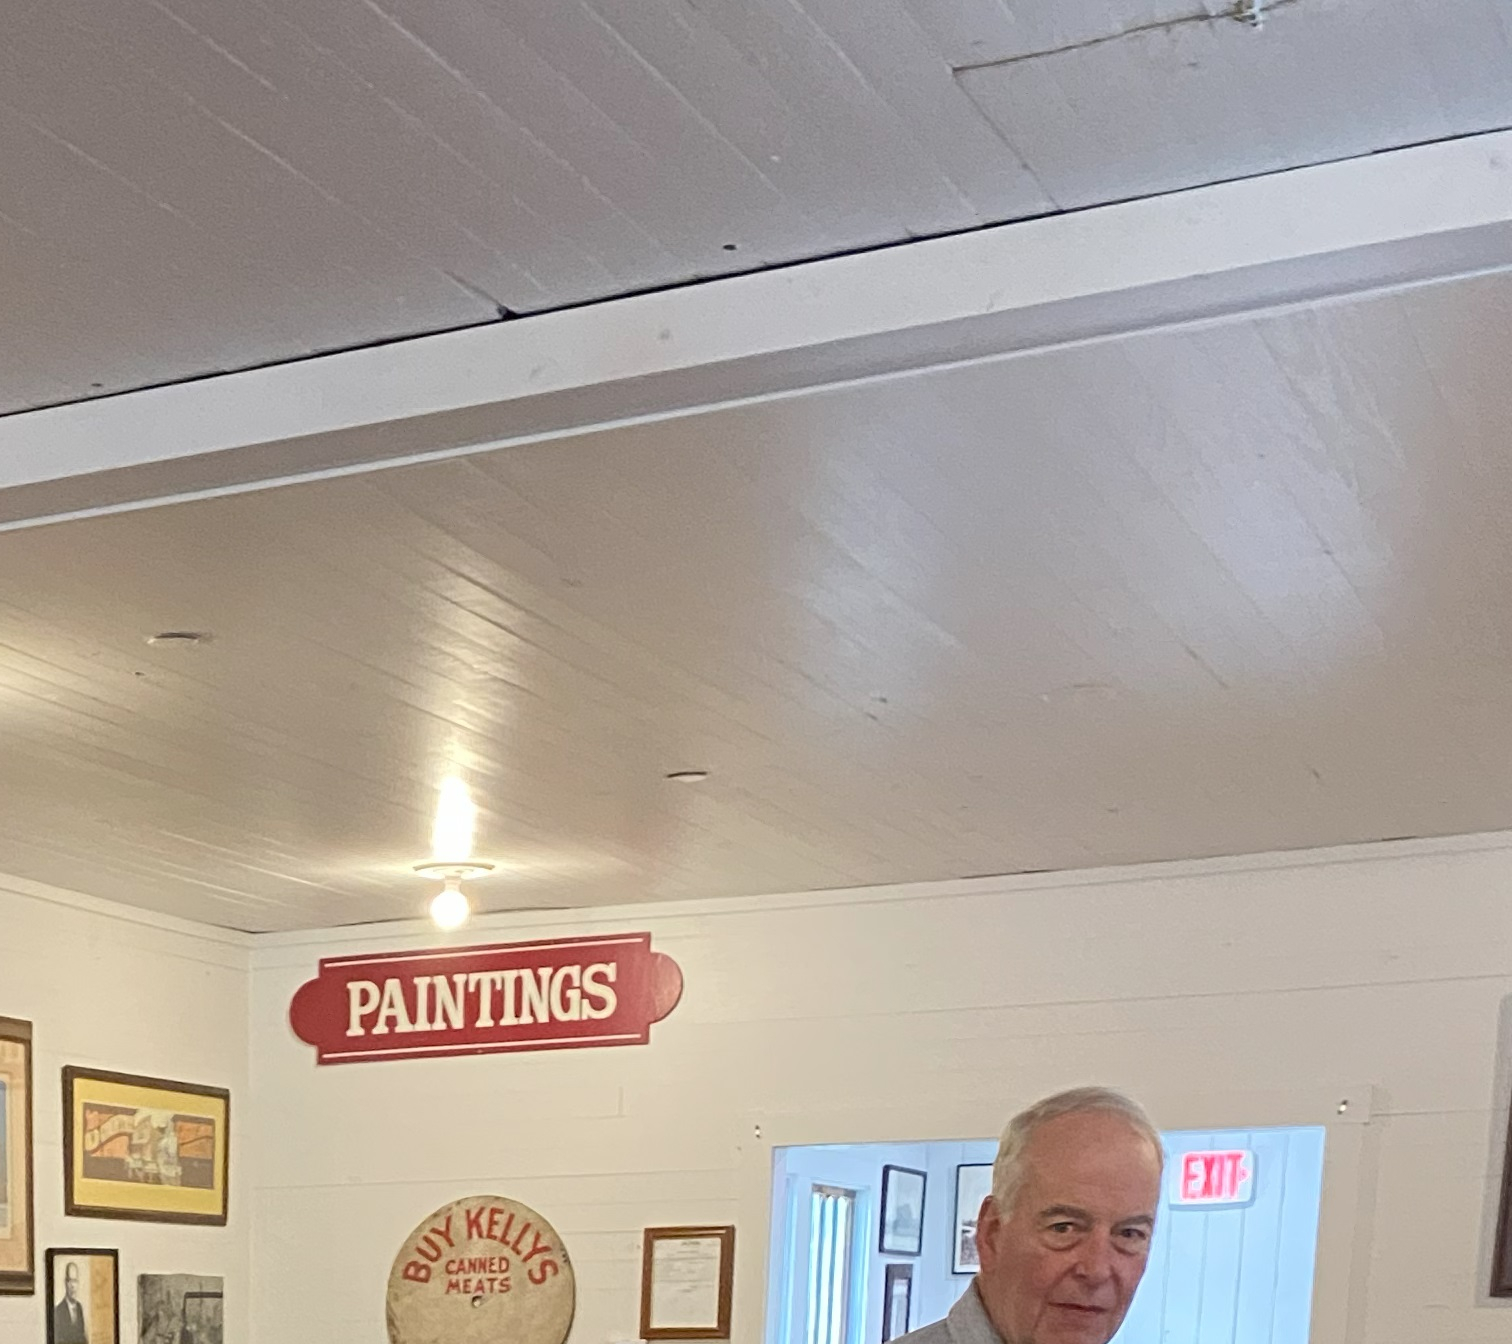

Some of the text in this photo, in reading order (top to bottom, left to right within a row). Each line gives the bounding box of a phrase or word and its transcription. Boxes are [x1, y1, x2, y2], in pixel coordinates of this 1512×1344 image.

[346, 962, 617, 1037] PAINTINGS
[1182, 1153, 1243, 1199] EXIT
[402, 1206, 559, 1285] BUY KELLYS
[445, 1256, 510, 1275] CANNED
[445, 1277, 512, 1294] MEATS
